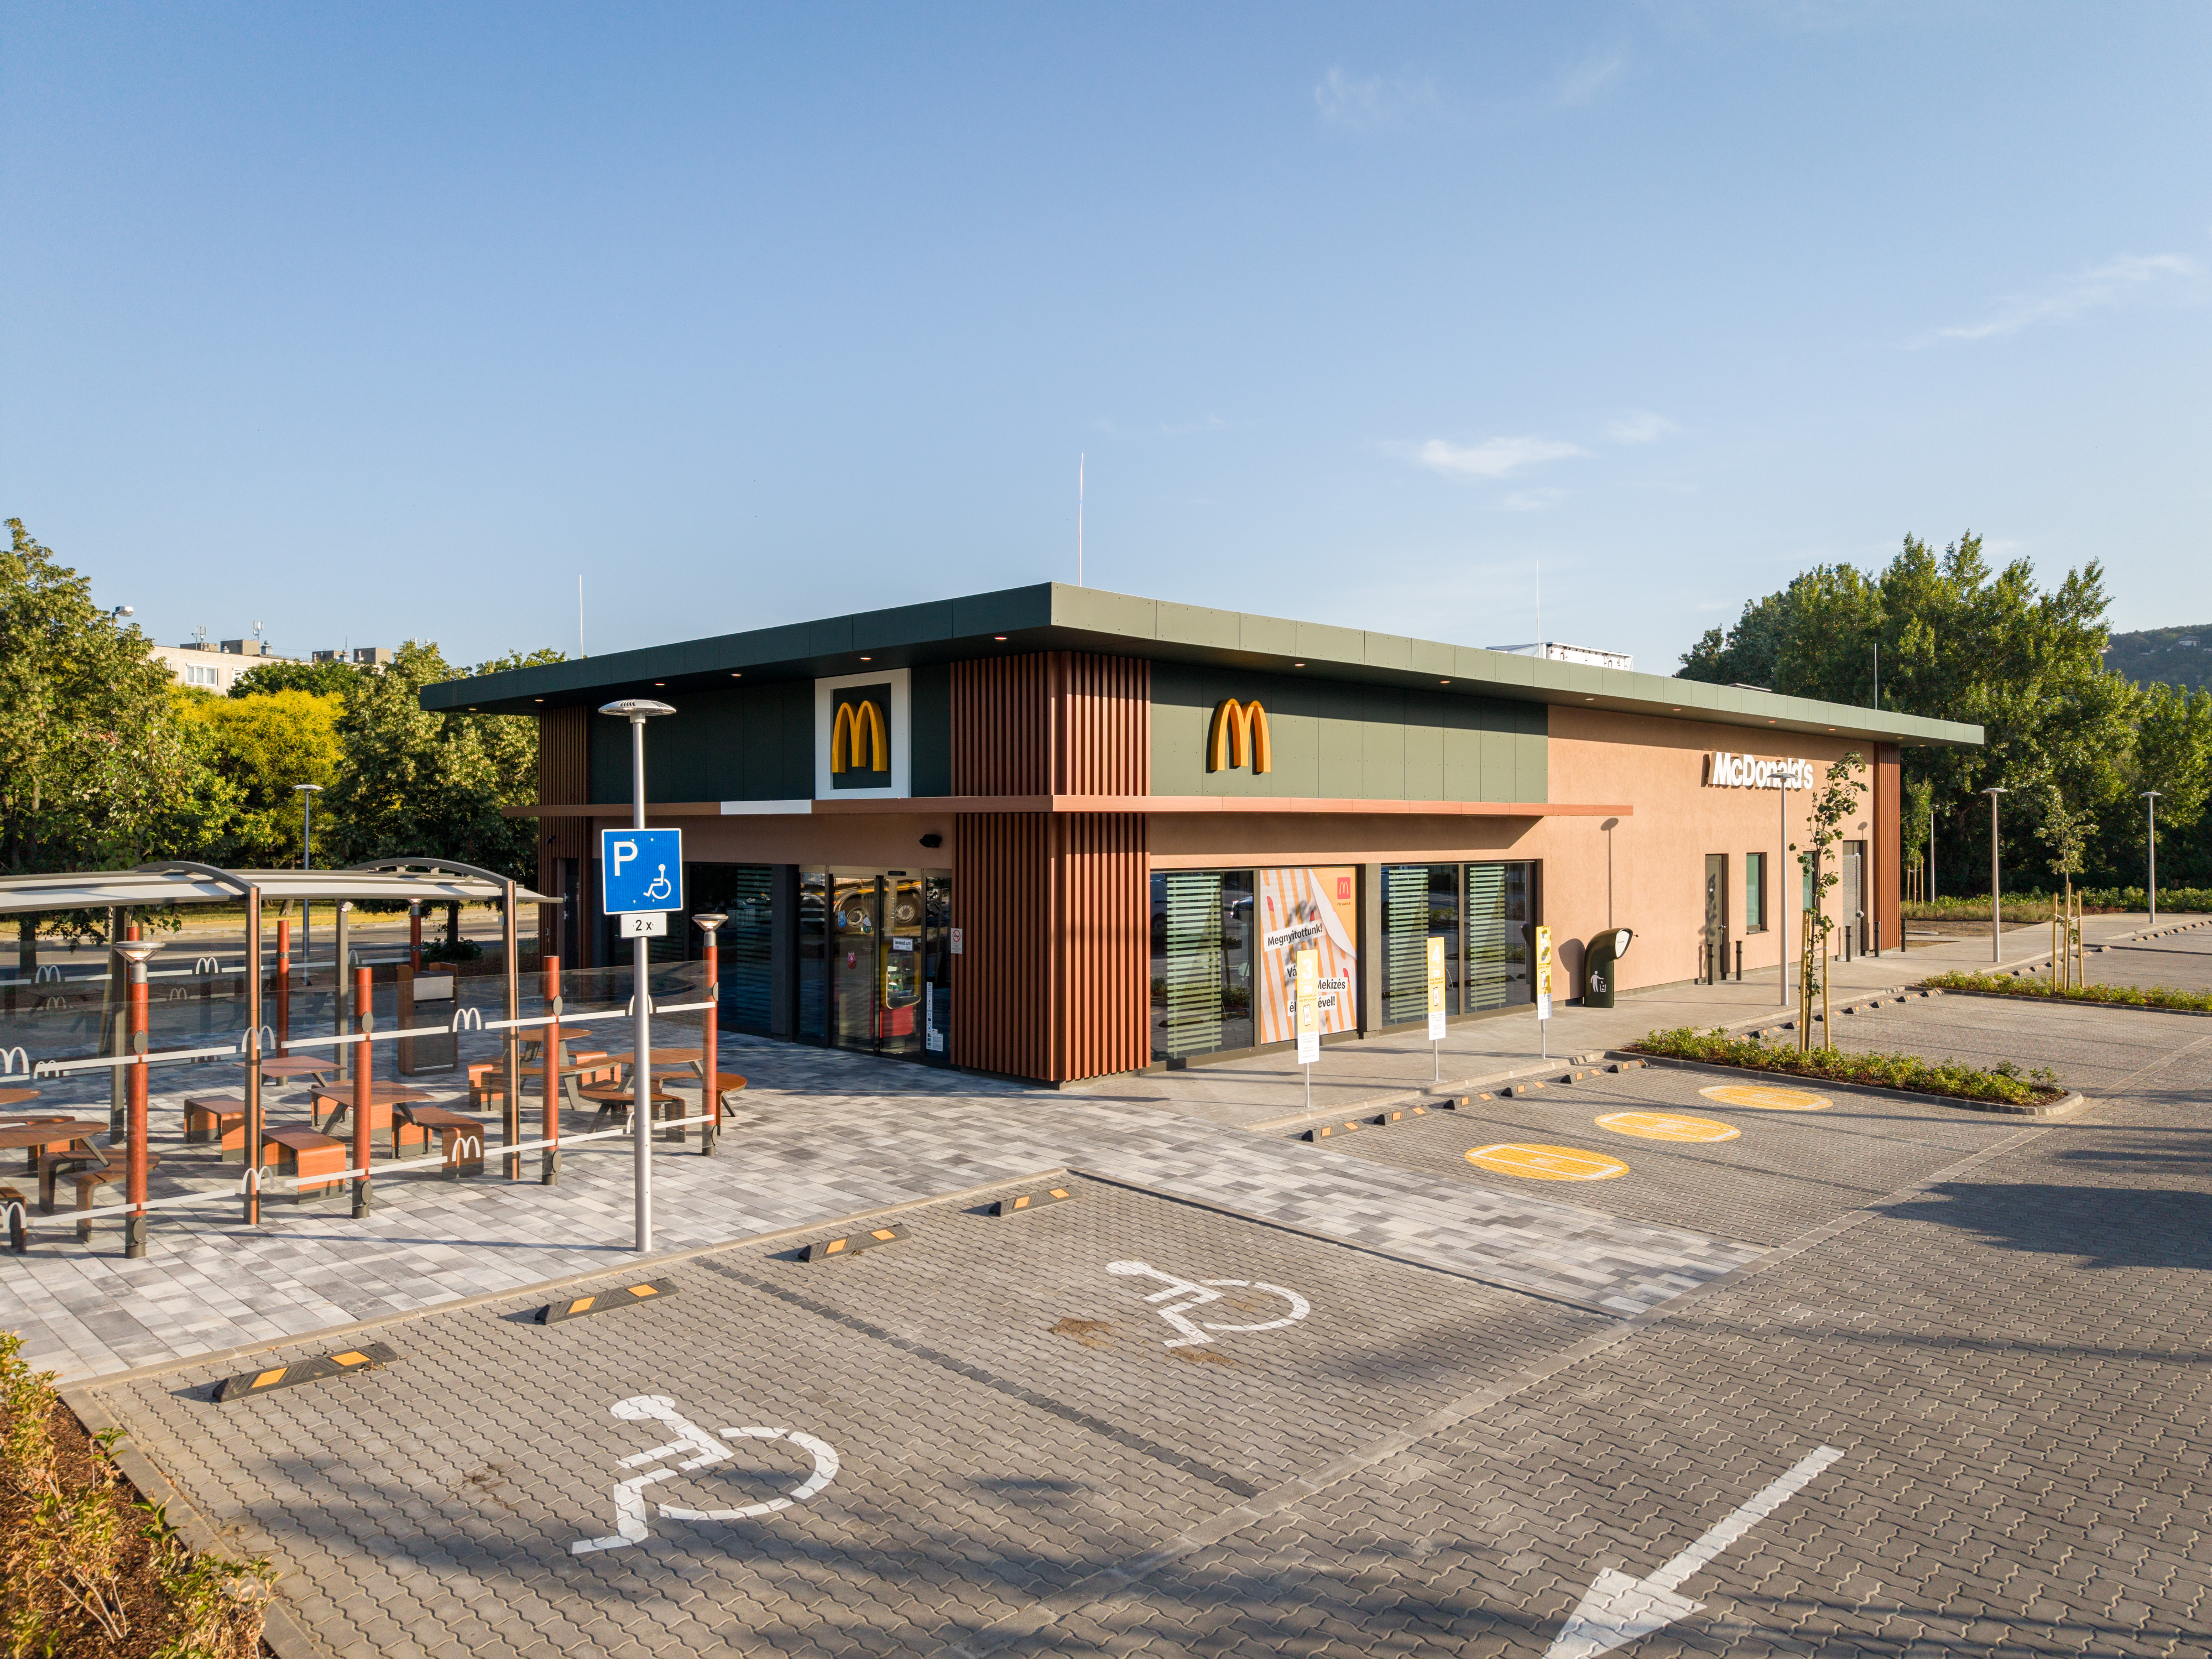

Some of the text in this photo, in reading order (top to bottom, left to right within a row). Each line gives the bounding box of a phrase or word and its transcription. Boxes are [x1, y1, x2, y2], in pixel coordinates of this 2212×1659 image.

[1712, 752, 1813, 790] McDonald's
[614, 841, 638, 877] P
[635, 920, 653, 931] 2 x
[1267, 924, 1323, 946] Megnyitottunk!
[1432, 946, 1441, 964] 4
[1302, 959, 1313, 979] 3
